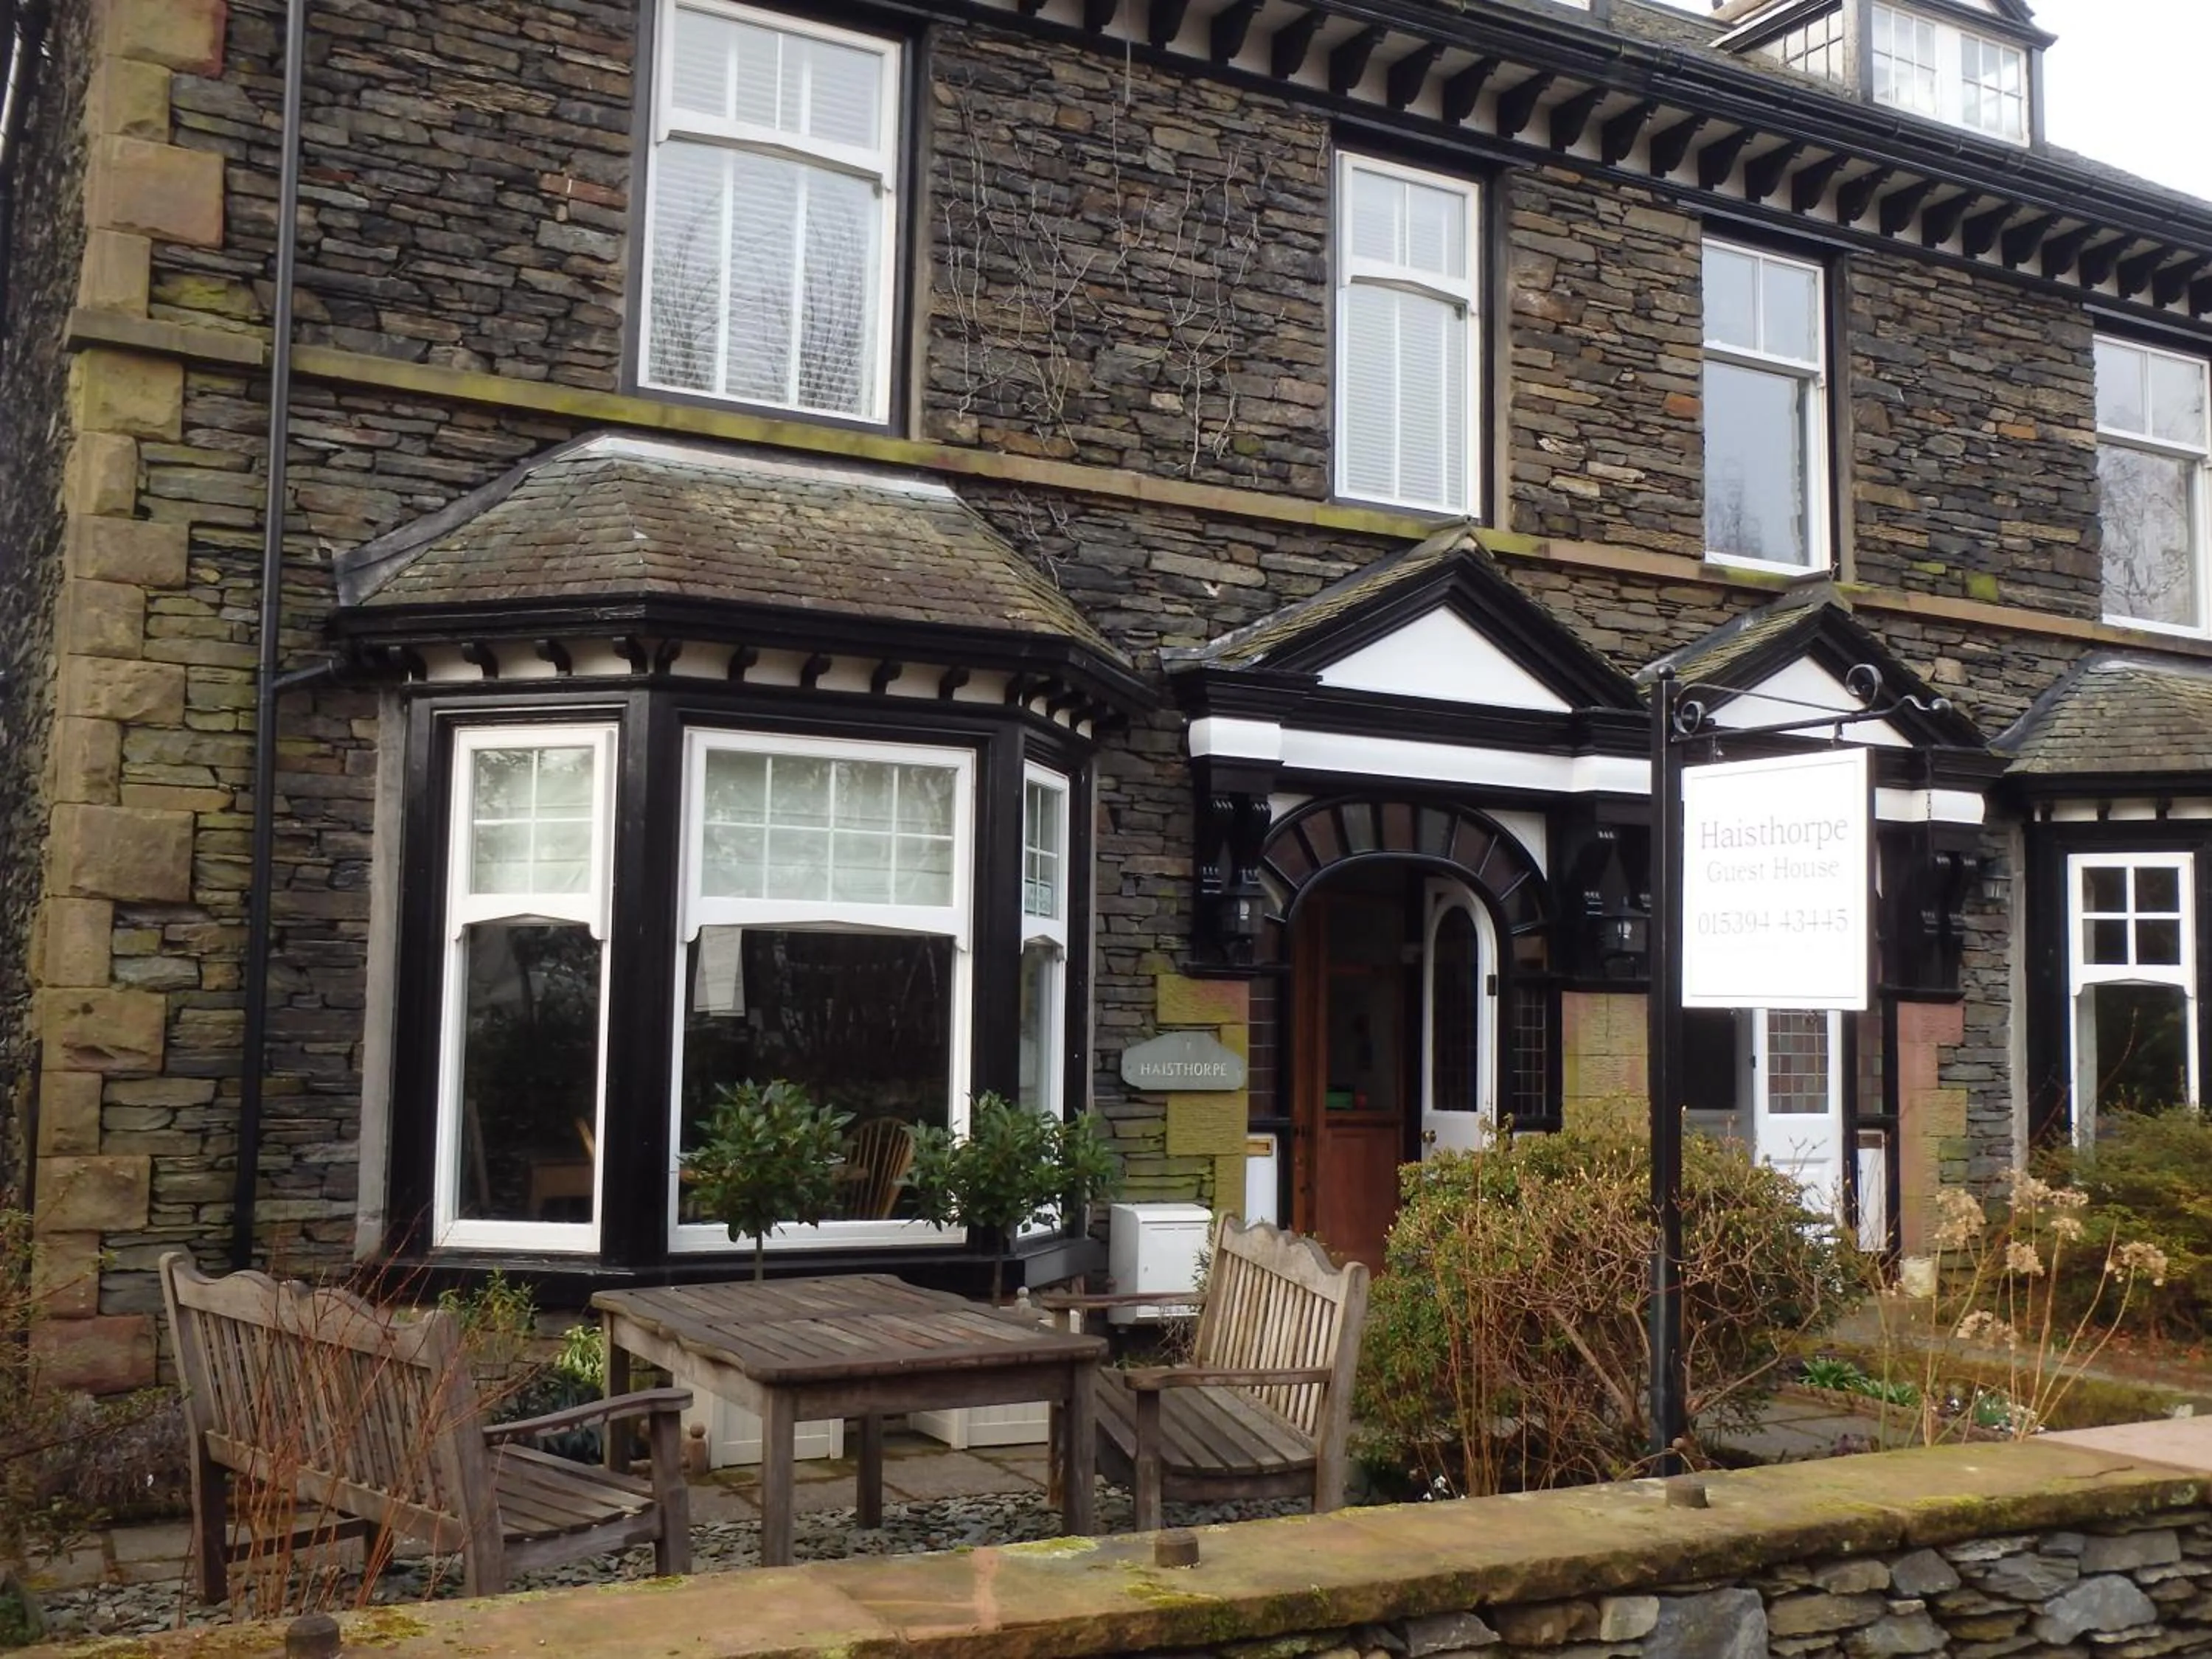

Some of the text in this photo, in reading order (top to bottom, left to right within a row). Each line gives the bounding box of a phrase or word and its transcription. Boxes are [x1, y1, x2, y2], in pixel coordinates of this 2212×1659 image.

[1700, 815, 1848, 850] Haisthorpe
[1707, 857, 1839, 883] Guest House
[1698, 908, 1848, 935] 015394 43445
[1141, 1062, 1227, 1076] HAISTHORPE
